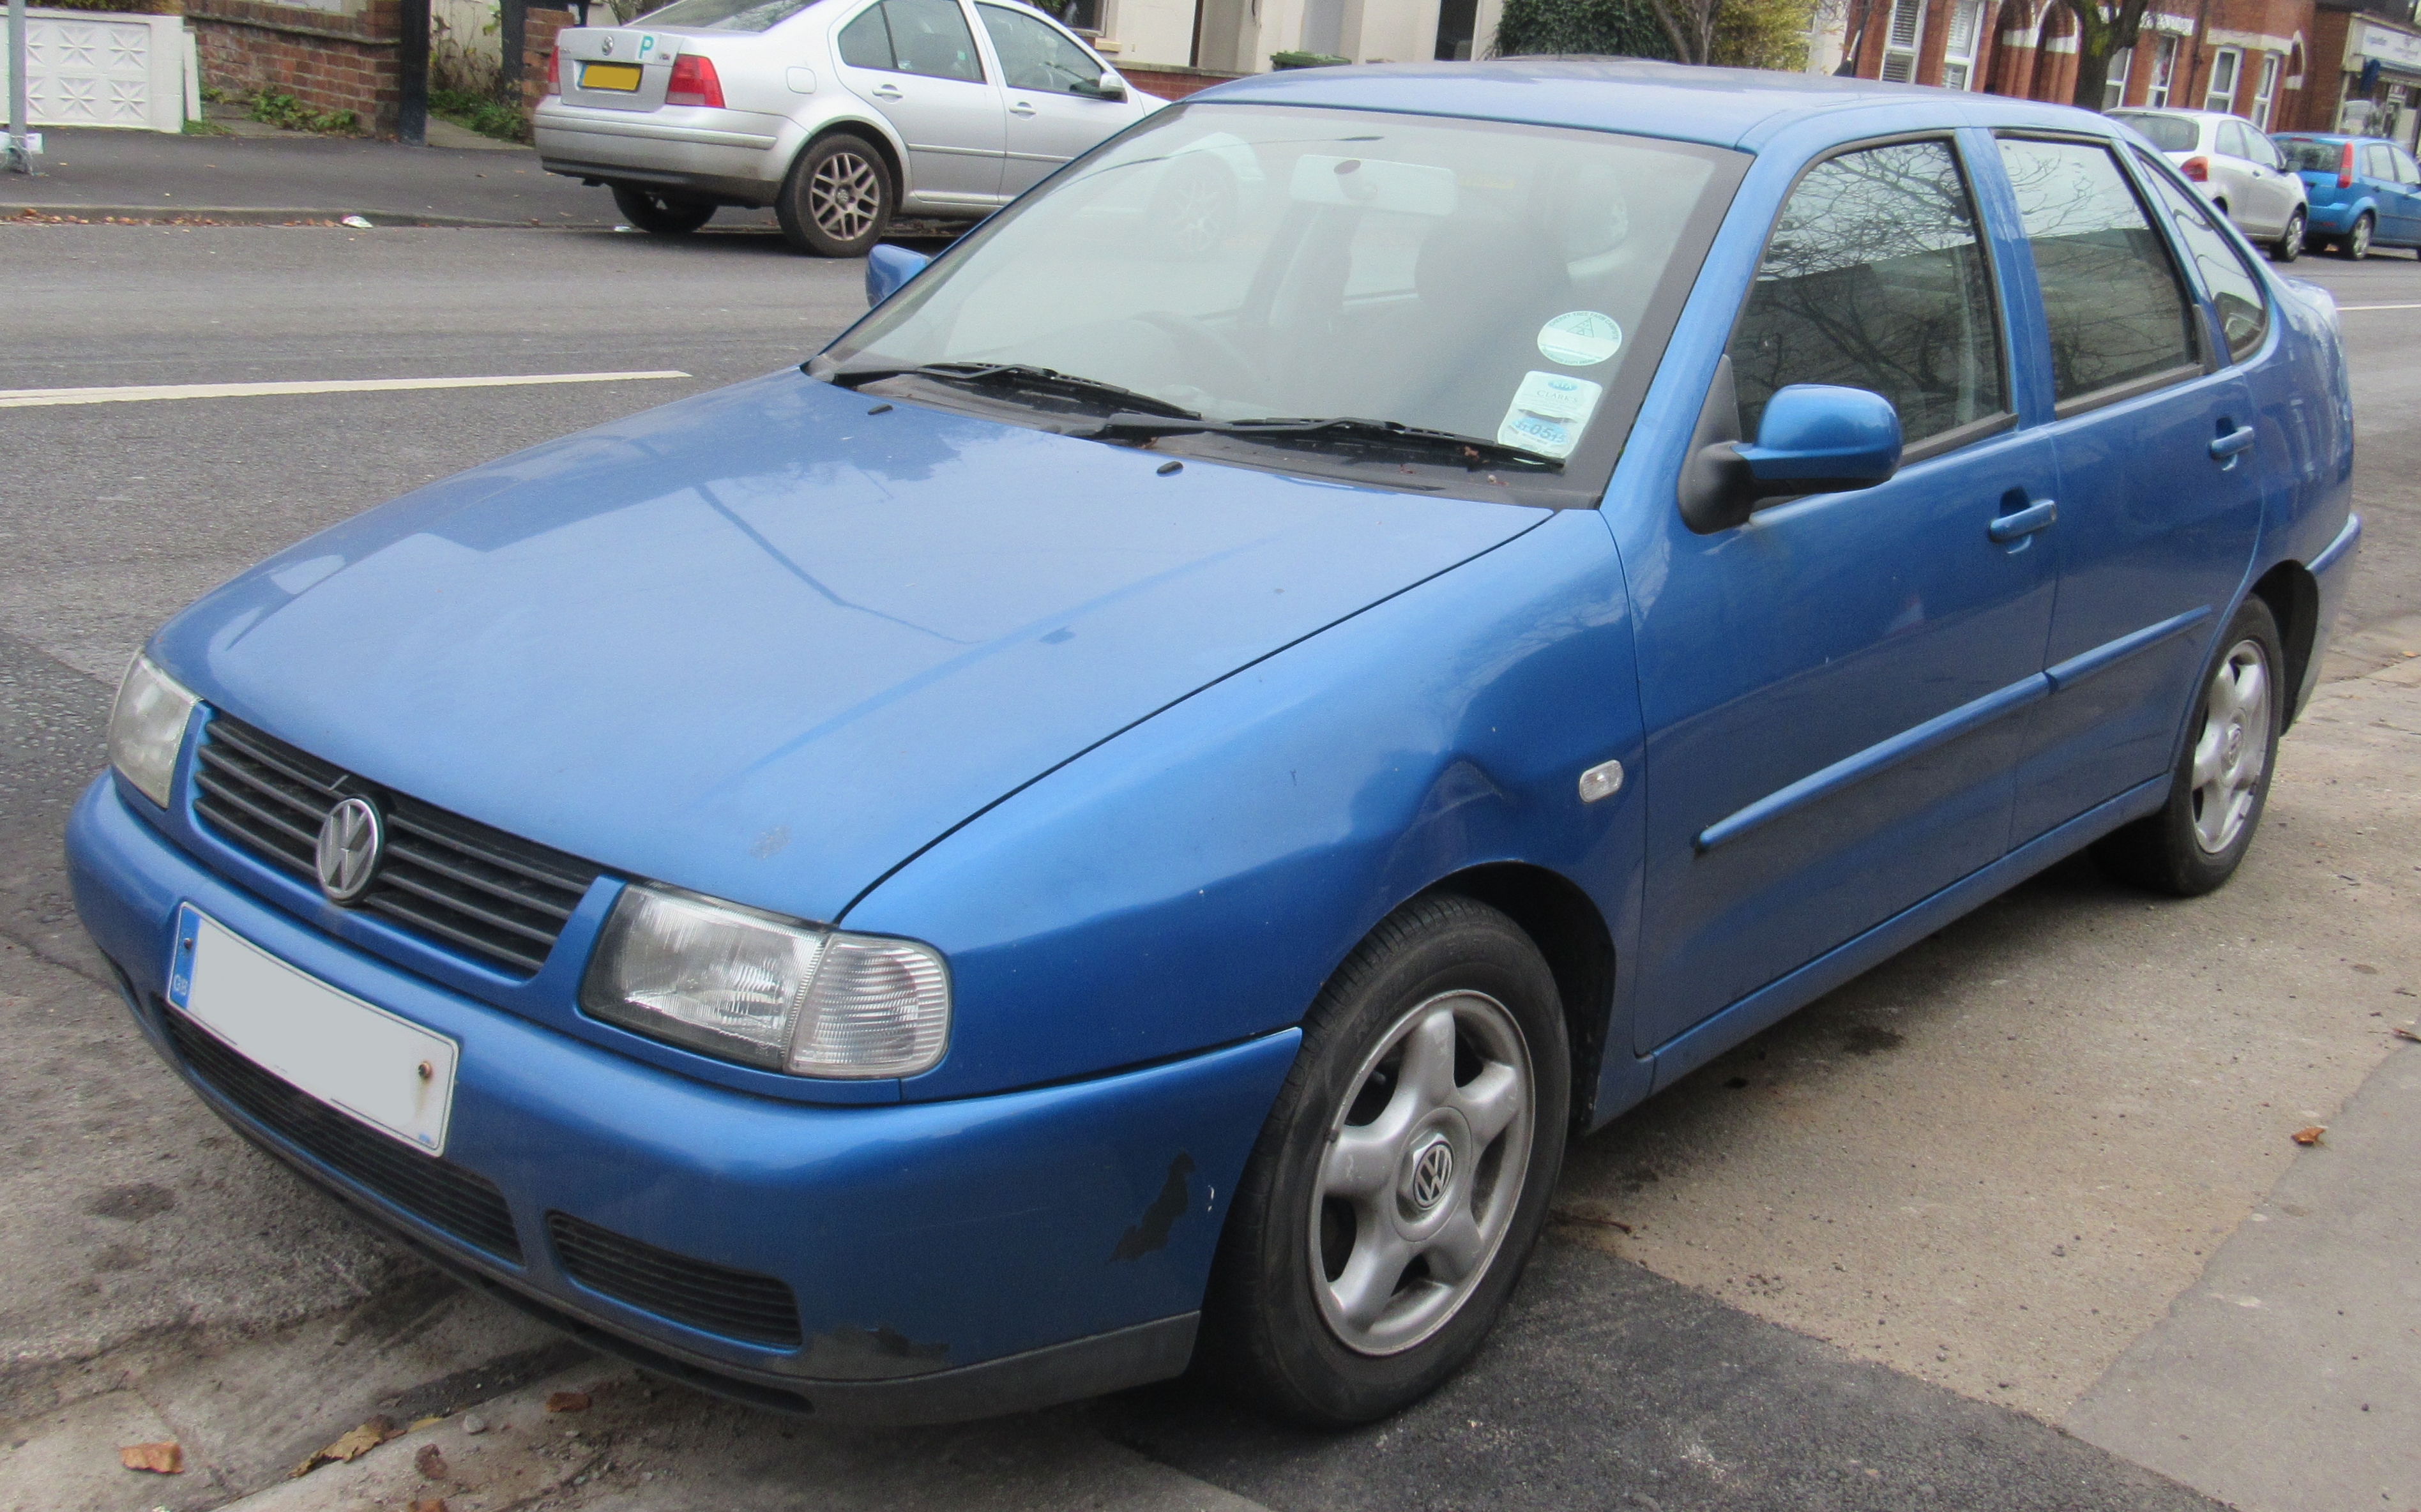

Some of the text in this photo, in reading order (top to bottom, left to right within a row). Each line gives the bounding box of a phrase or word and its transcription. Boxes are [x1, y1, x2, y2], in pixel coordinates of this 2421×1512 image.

[639, 36, 654, 59] P
[1549, 314, 1570, 326] CHERRY
[1590, 313, 1606, 321] FARM
[174, 974, 188, 996] GB
[1413, 1142, 1453, 1206] VW
